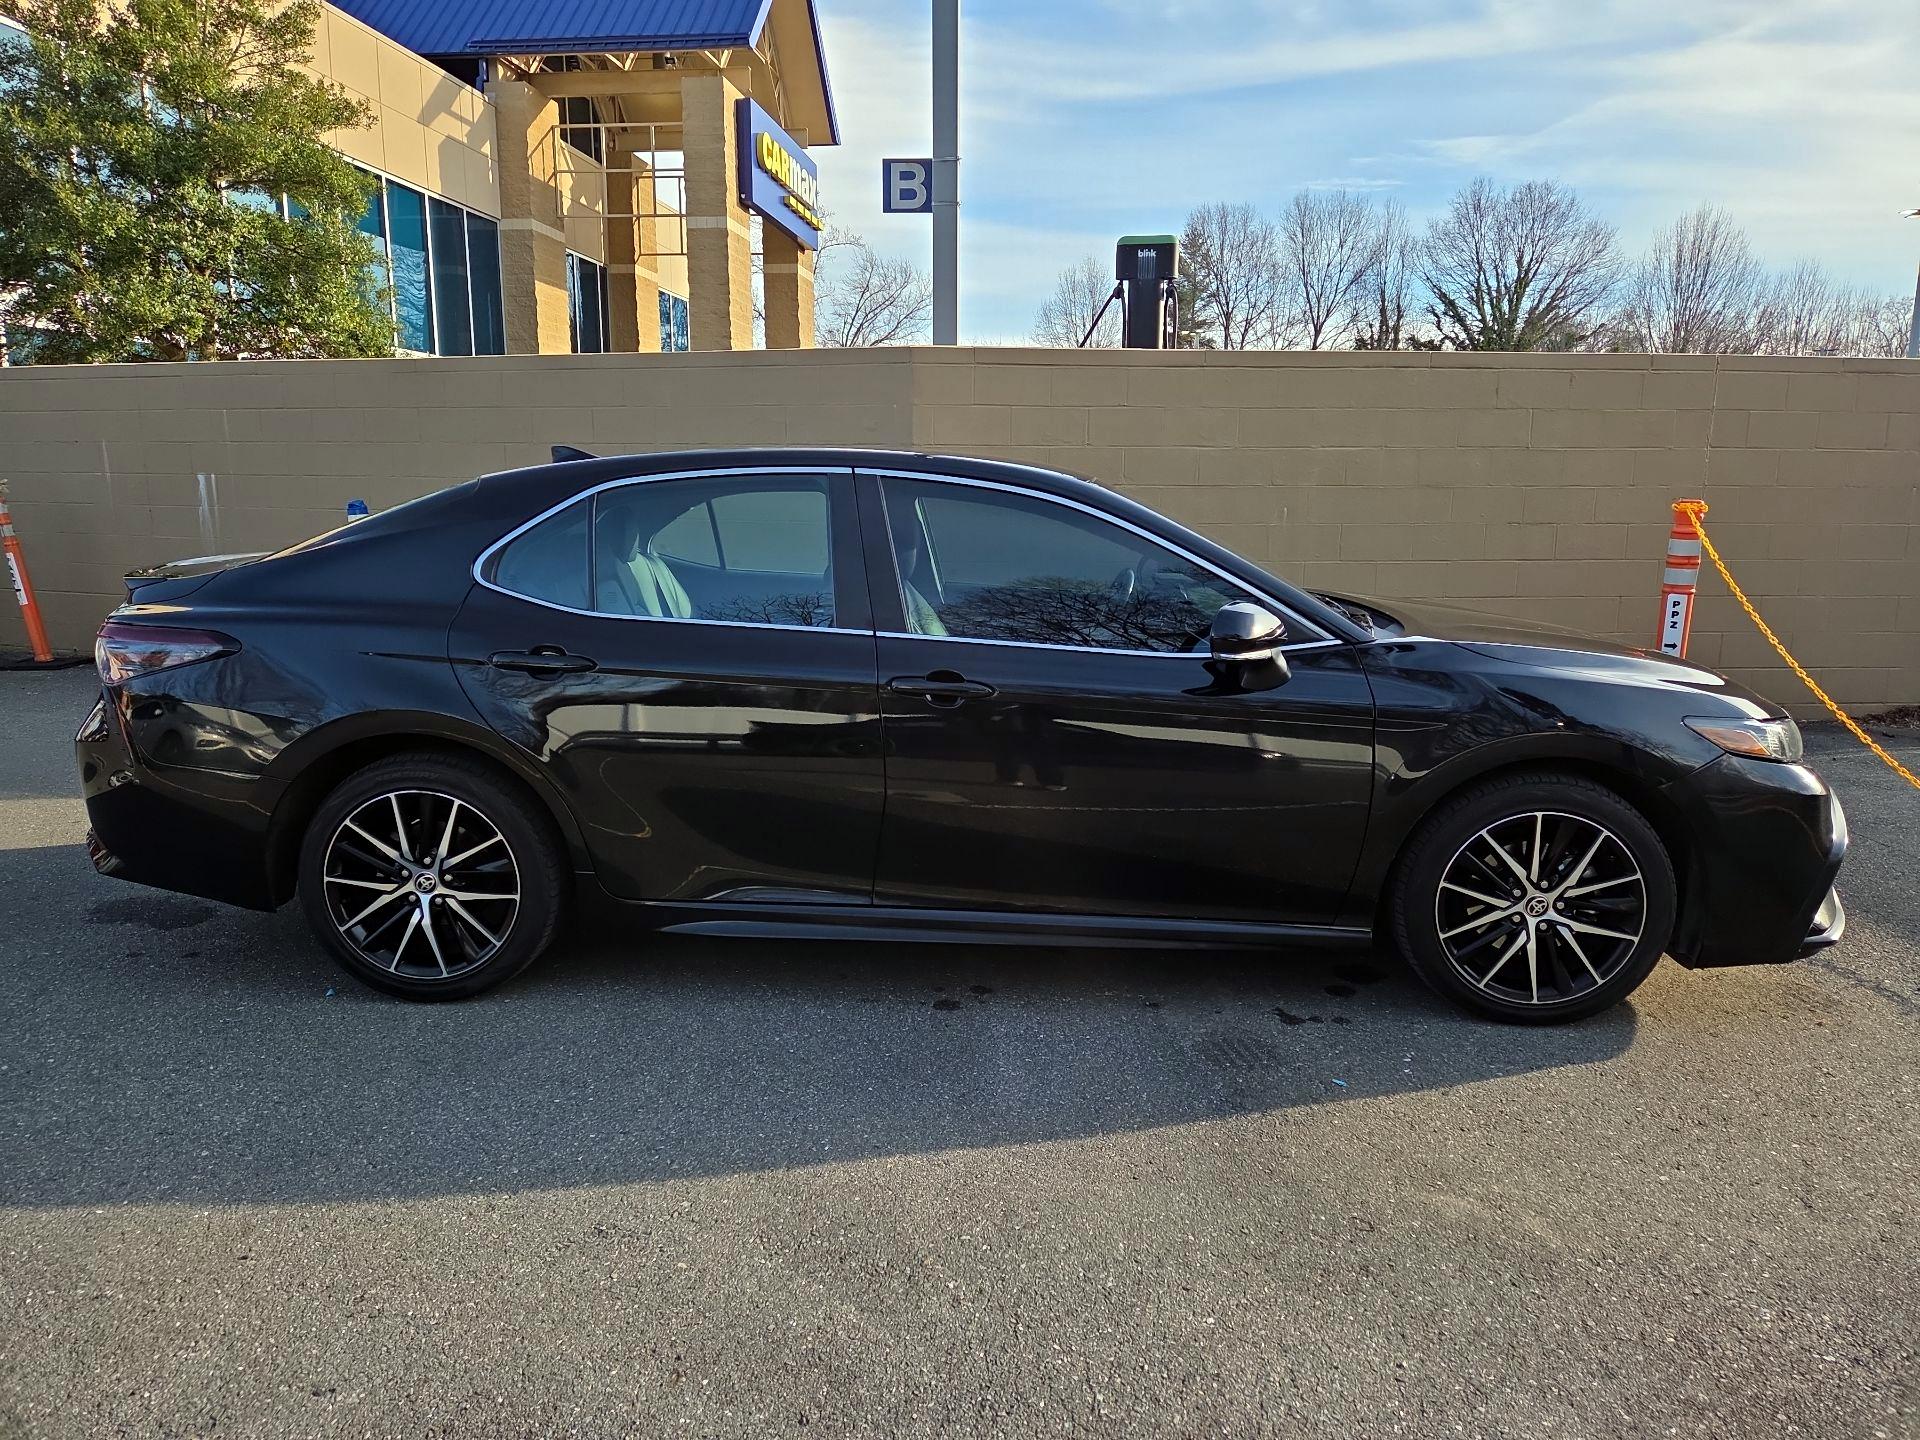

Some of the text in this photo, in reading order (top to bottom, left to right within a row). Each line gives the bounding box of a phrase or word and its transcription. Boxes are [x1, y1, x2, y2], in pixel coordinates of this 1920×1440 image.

[890, 162, 927, 210] B
[1137, 248, 1157, 258] blink
[1669, 600, 1681, 629] PPZ
